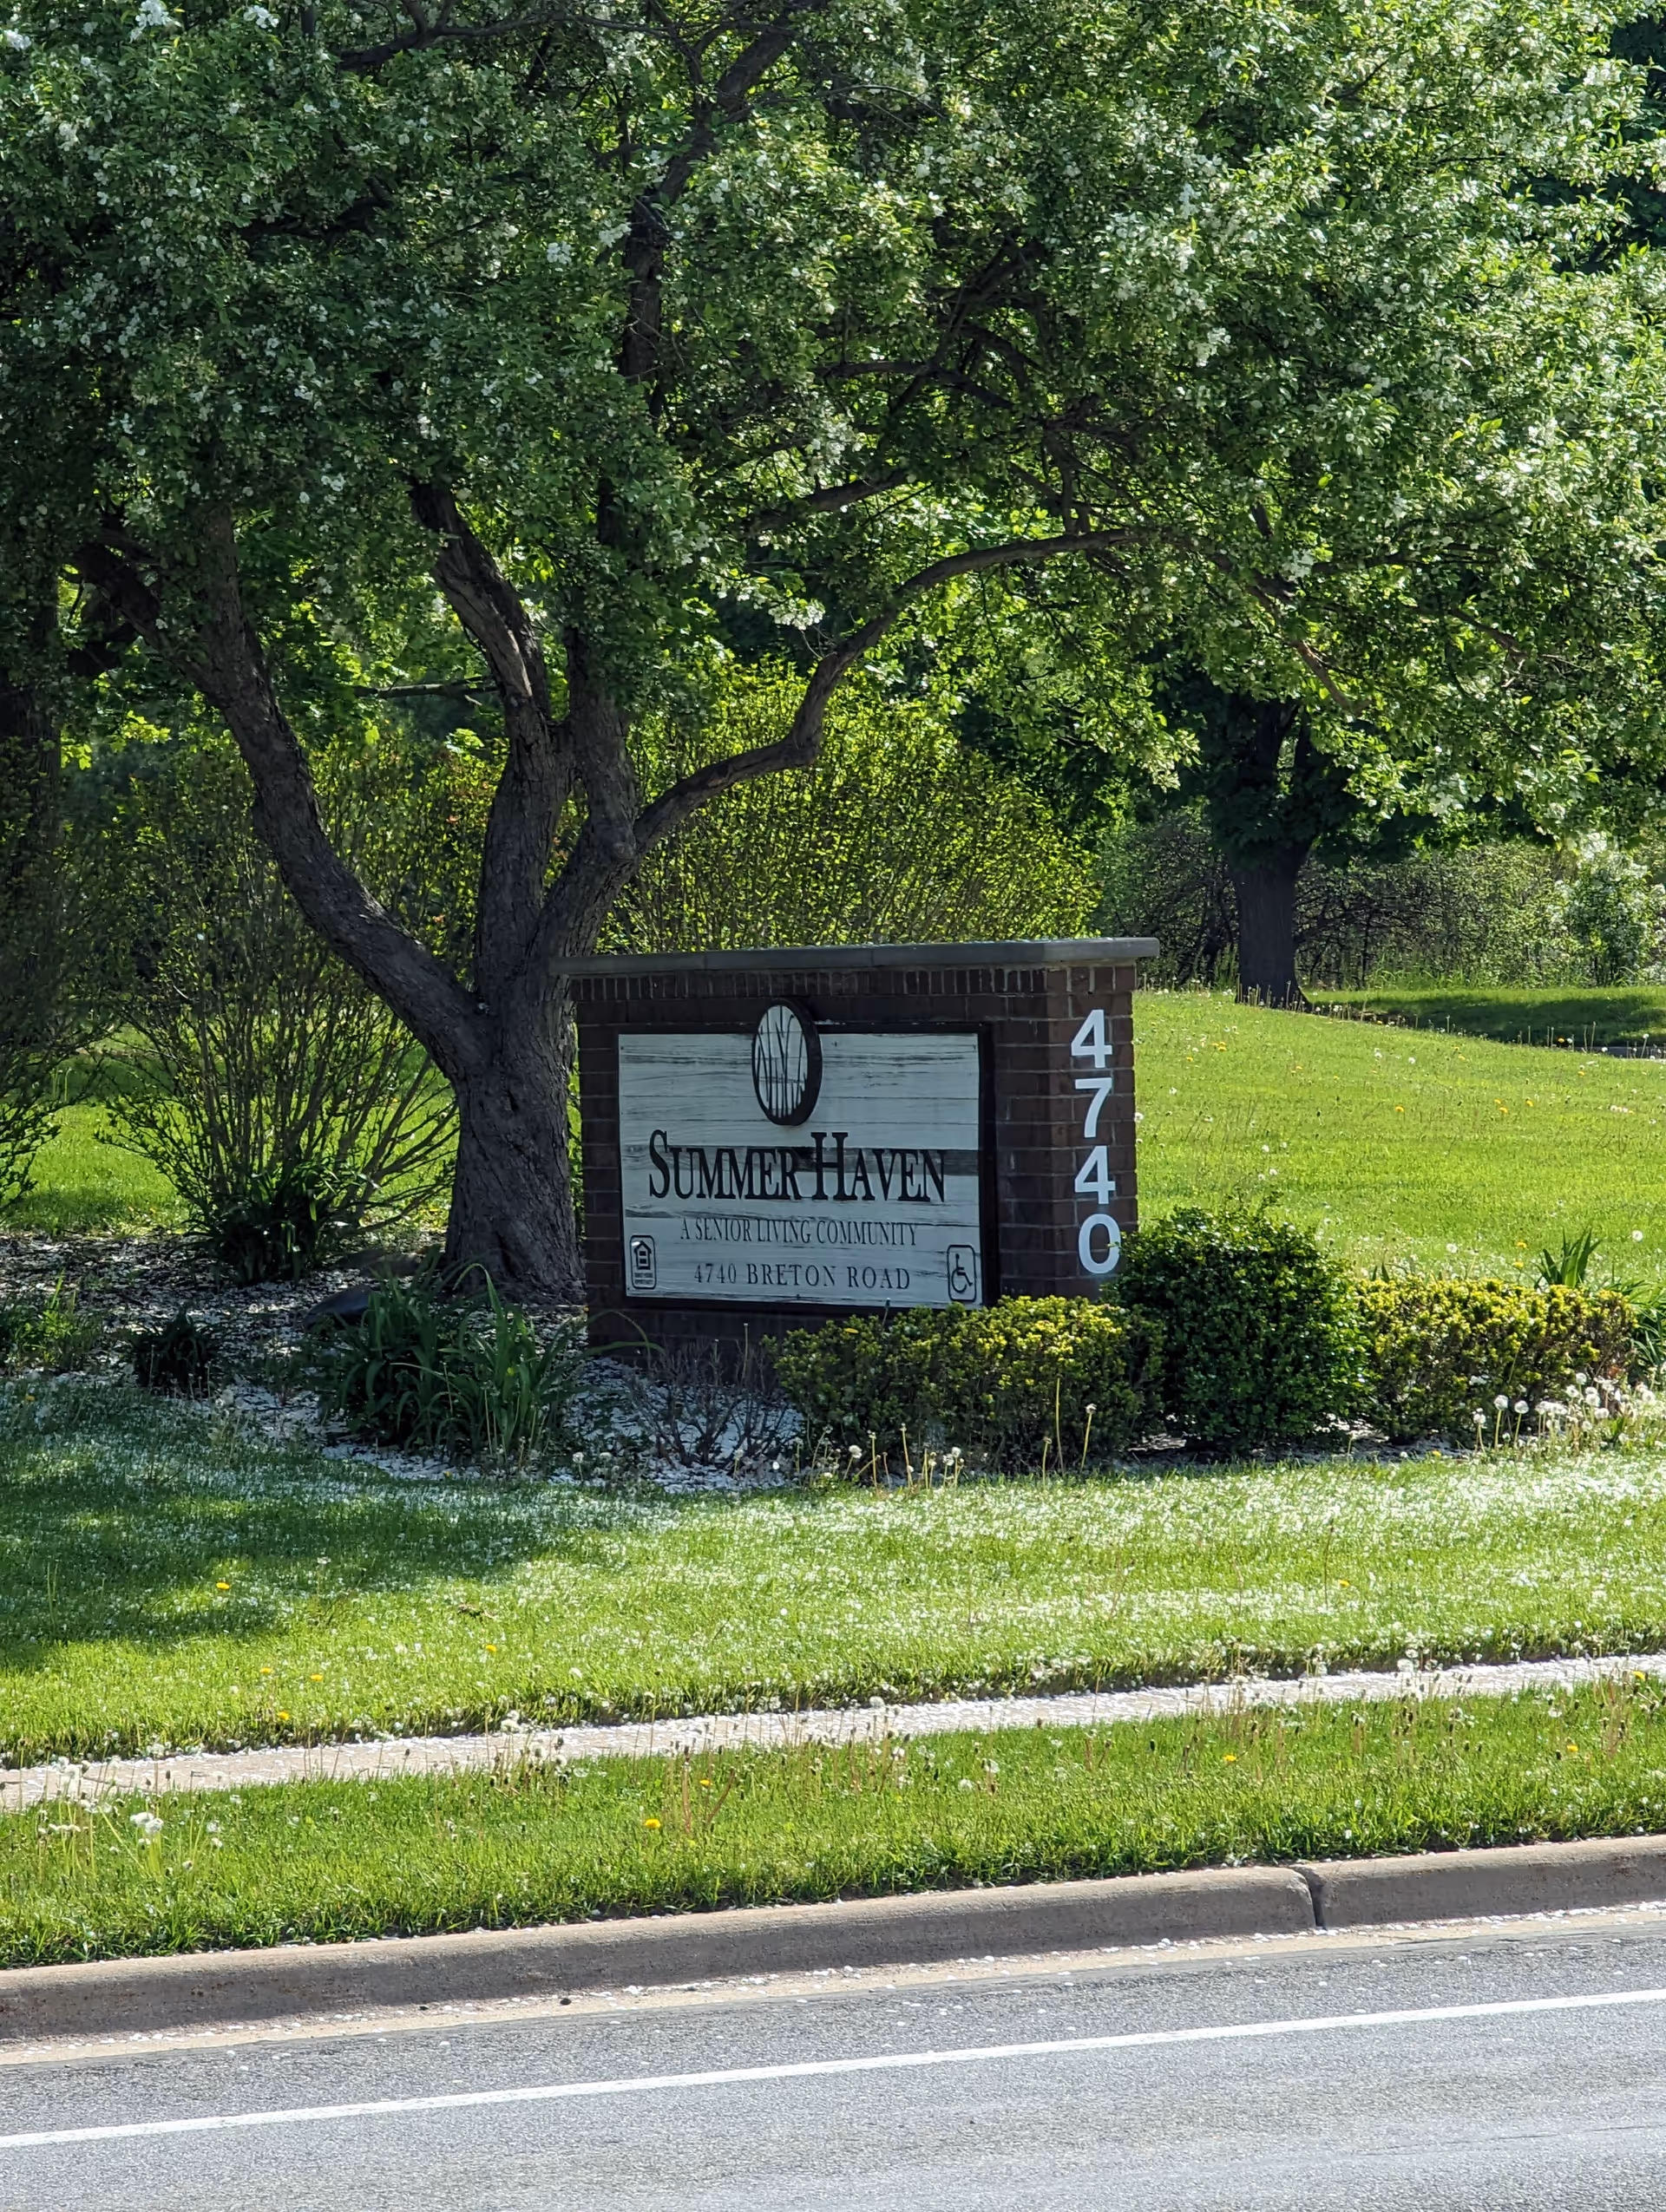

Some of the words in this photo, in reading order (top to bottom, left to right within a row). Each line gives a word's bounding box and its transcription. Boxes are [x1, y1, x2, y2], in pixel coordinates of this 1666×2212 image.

[649, 1129, 802, 1200] SUMMER
[811, 1132, 945, 1202] HAVEN
[1071, 1009, 1121, 1274] 4740
[680, 1218, 691, 1240] A
[695, 1218, 752, 1241] SENIOR
[758, 1219, 811, 1243] LIVING
[817, 1220, 916, 1246] COMMUNITY
[694, 1263, 737, 1284] 4740
[746, 1263, 836, 1286] BRETON
[847, 1266, 910, 1289] ROAD
